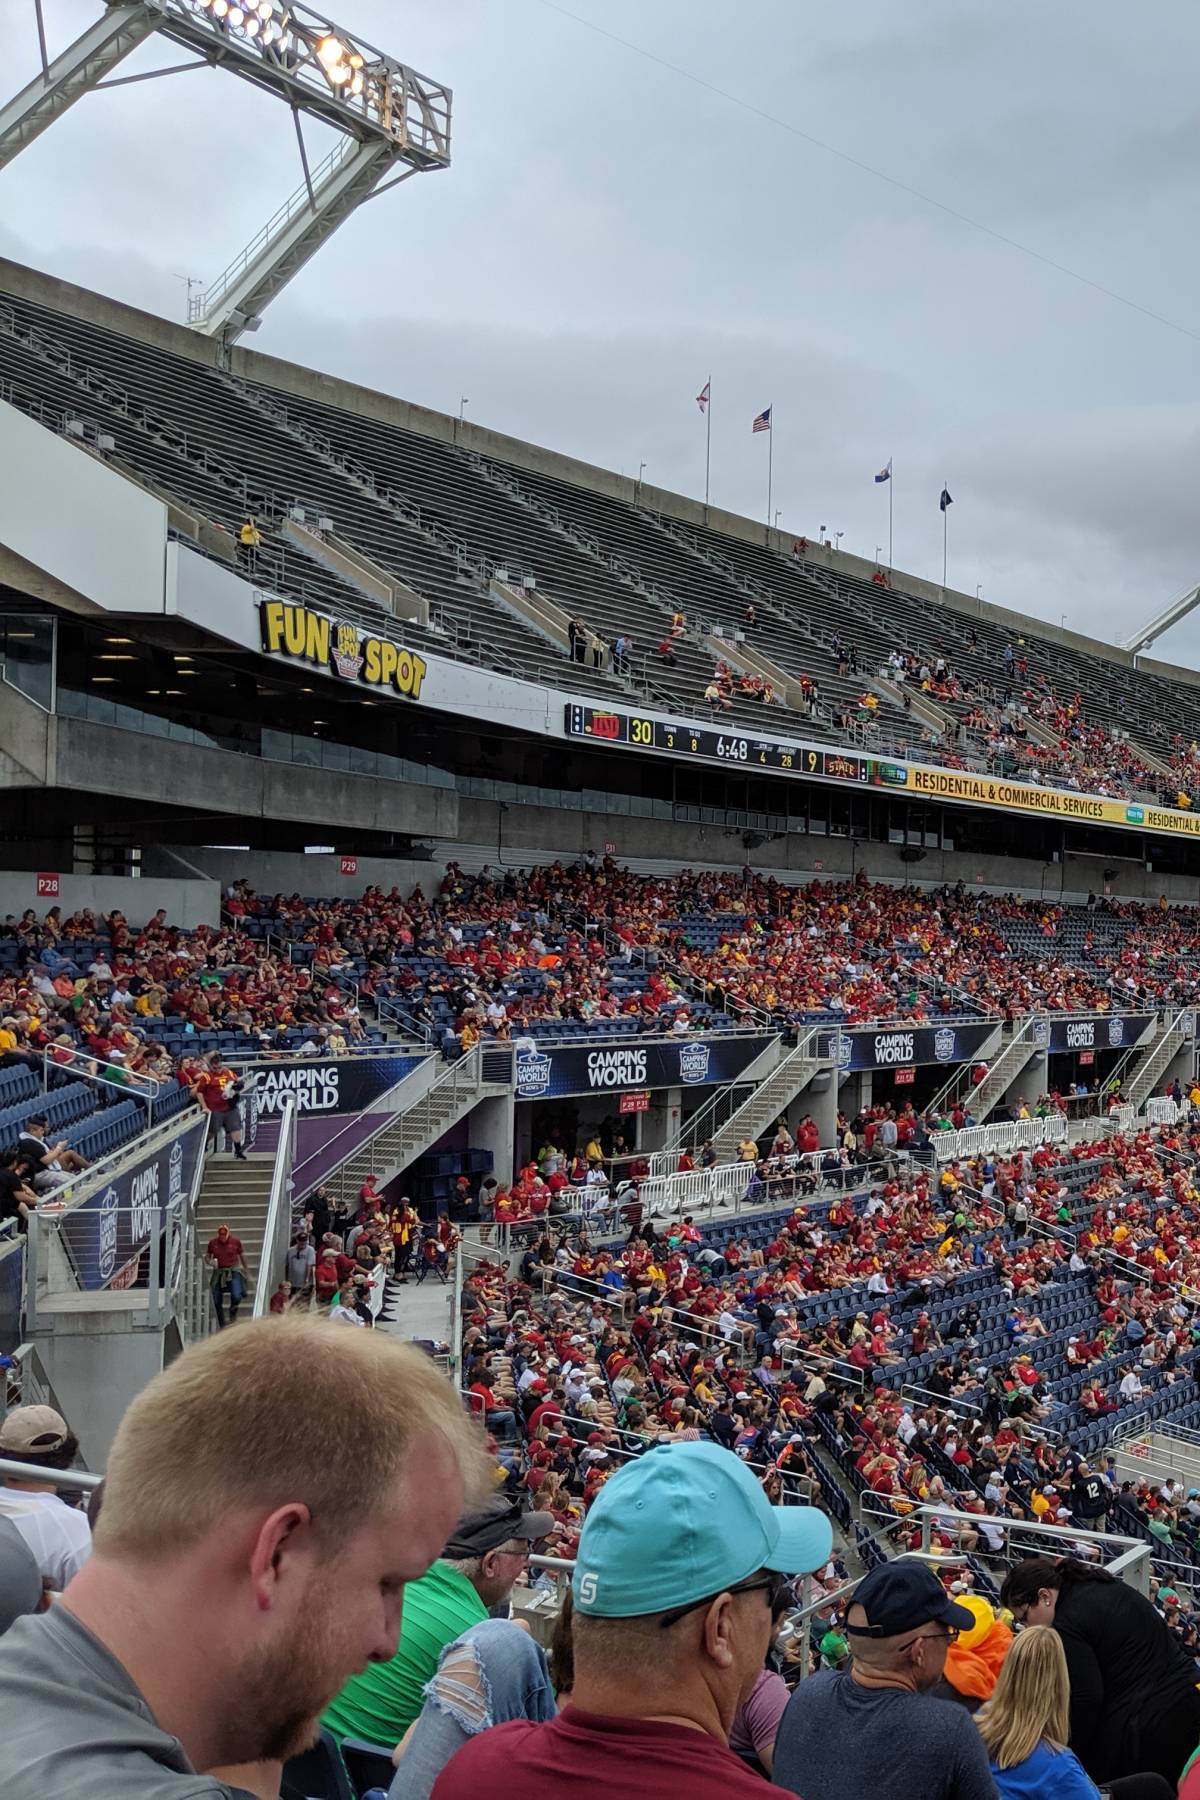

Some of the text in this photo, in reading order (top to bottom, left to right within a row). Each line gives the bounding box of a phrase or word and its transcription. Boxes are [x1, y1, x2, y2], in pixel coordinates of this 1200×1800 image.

[338, 624, 357, 643] FUN
[264, 601, 330, 666] FUN
[364, 638, 427, 700] SPOT
[631, 719, 651, 744] 30
[667, 735, 673, 747] 3
[691, 739, 698, 752] 8
[716, 736, 748, 761] 6:48
[760, 751, 766, 763] 4
[781, 755, 792, 767] 28
[808, 751, 817, 772] 9
[828, 760, 855, 777] STATE
[915, 771, 986, 798] RESIDENTIAL
[988, 785, 995, 798] &
[998, 787, 1060, 811] COMMERCIAL
[1063, 797, 1103, 817] SERVICES
[1148, 812, 1194, 831] RESIDENTIAL
[1195, 820, 1200, 831] &
[341, 861, 356, 871] P29
[38, 879, 58, 892] P28
[1067, 1023, 1095, 1034] CAMPING
[875, 1033, 914, 1048] CAMPING
[1067, 1033, 1095, 1047] WORLD
[588, 1049, 647, 1068] CAMPING
[875, 1046, 914, 1063] WORLD
[518, 1064, 548, 1074] CAMPING
[682, 1061, 706, 1071] WORLD
[255, 1067, 339, 1091] CAMPING
[518, 1072, 547, 1082] WORLD
[588, 1066, 647, 1087] WORLD
[256, 1087, 339, 1114] WORLD
[131, 1162, 159, 1209] CAMPING
[1087, 1482, 1100, 1498] 12
